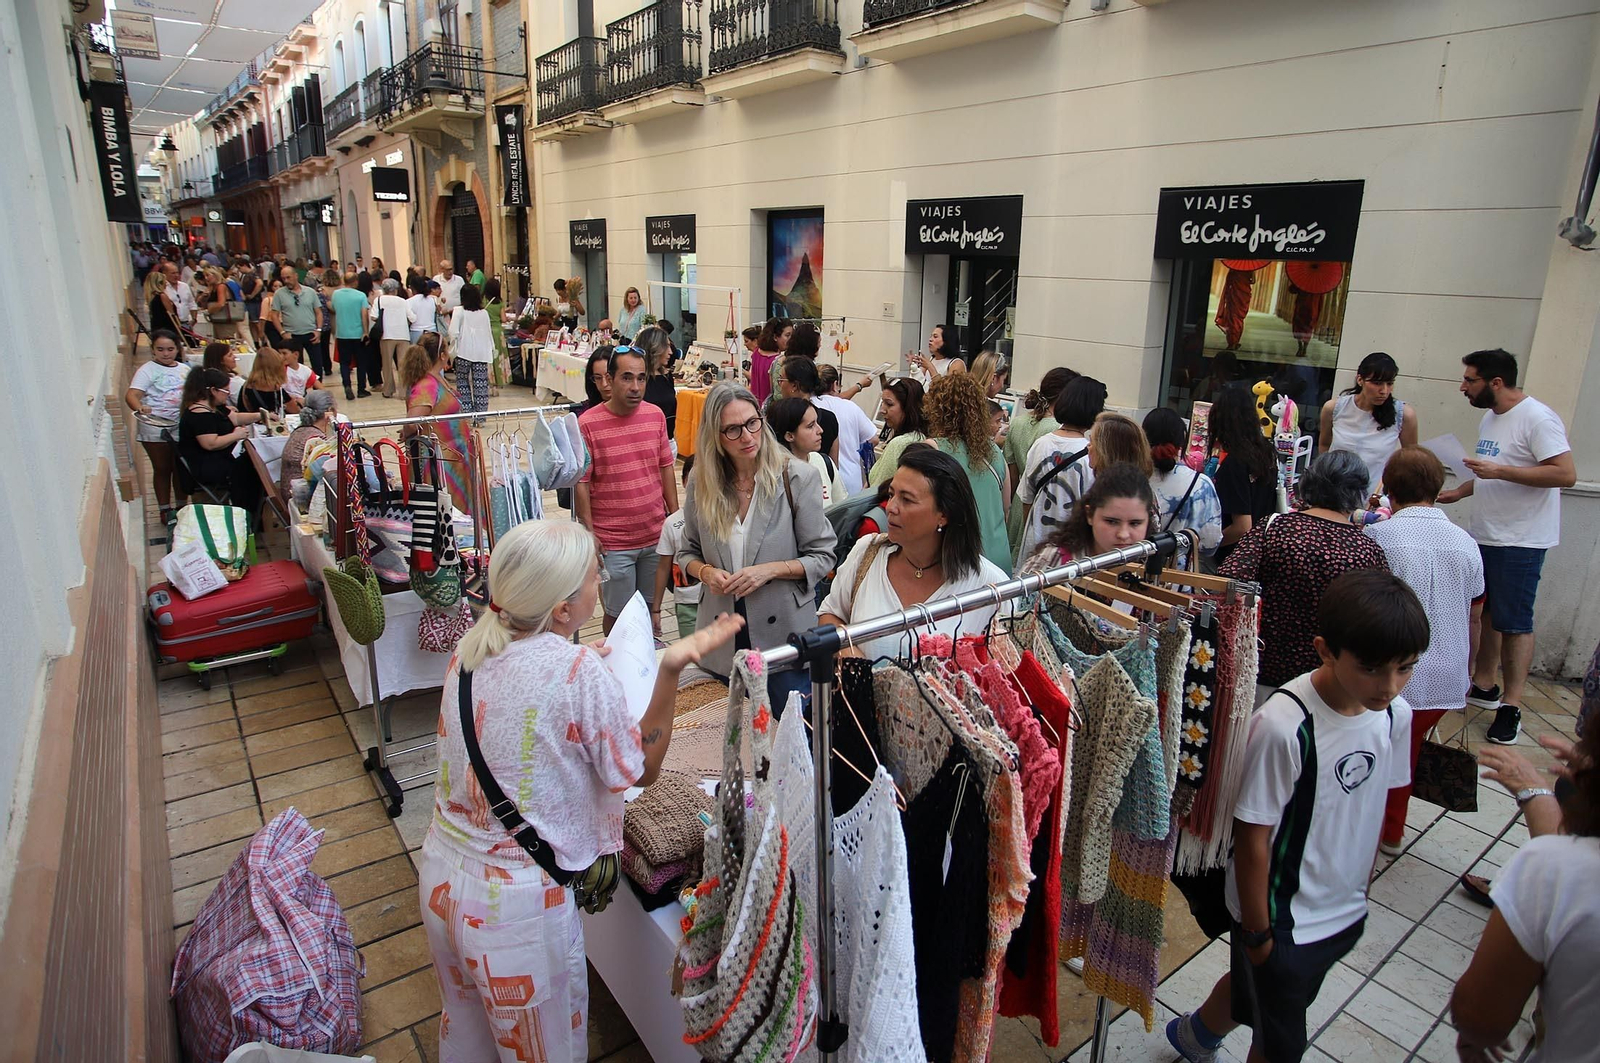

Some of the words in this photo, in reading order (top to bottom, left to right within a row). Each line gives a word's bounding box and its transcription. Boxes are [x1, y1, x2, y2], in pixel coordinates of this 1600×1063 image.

[100, 106, 118, 150] BIMBA
[508, 134, 518, 159] ESTATE
[108, 154, 121, 162] Y
[510, 160, 518, 180] REAL
[110, 164, 126, 198] LOLA
[920, 206, 962, 219] VIAJES
[1184, 194, 1252, 212] VIAJES
[574, 224, 588, 232] VIAJES
[652, 221, 670, 230] VIAJES
[920, 224, 931, 243] El
[932, 225, 960, 243] Corte
[960, 220, 1004, 250] Inglés
[1180, 220, 1200, 244] El
[1200, 220, 1248, 244] Corte
[1248, 214, 1326, 252] Inglés
[658, 234, 670, 246] Corte
